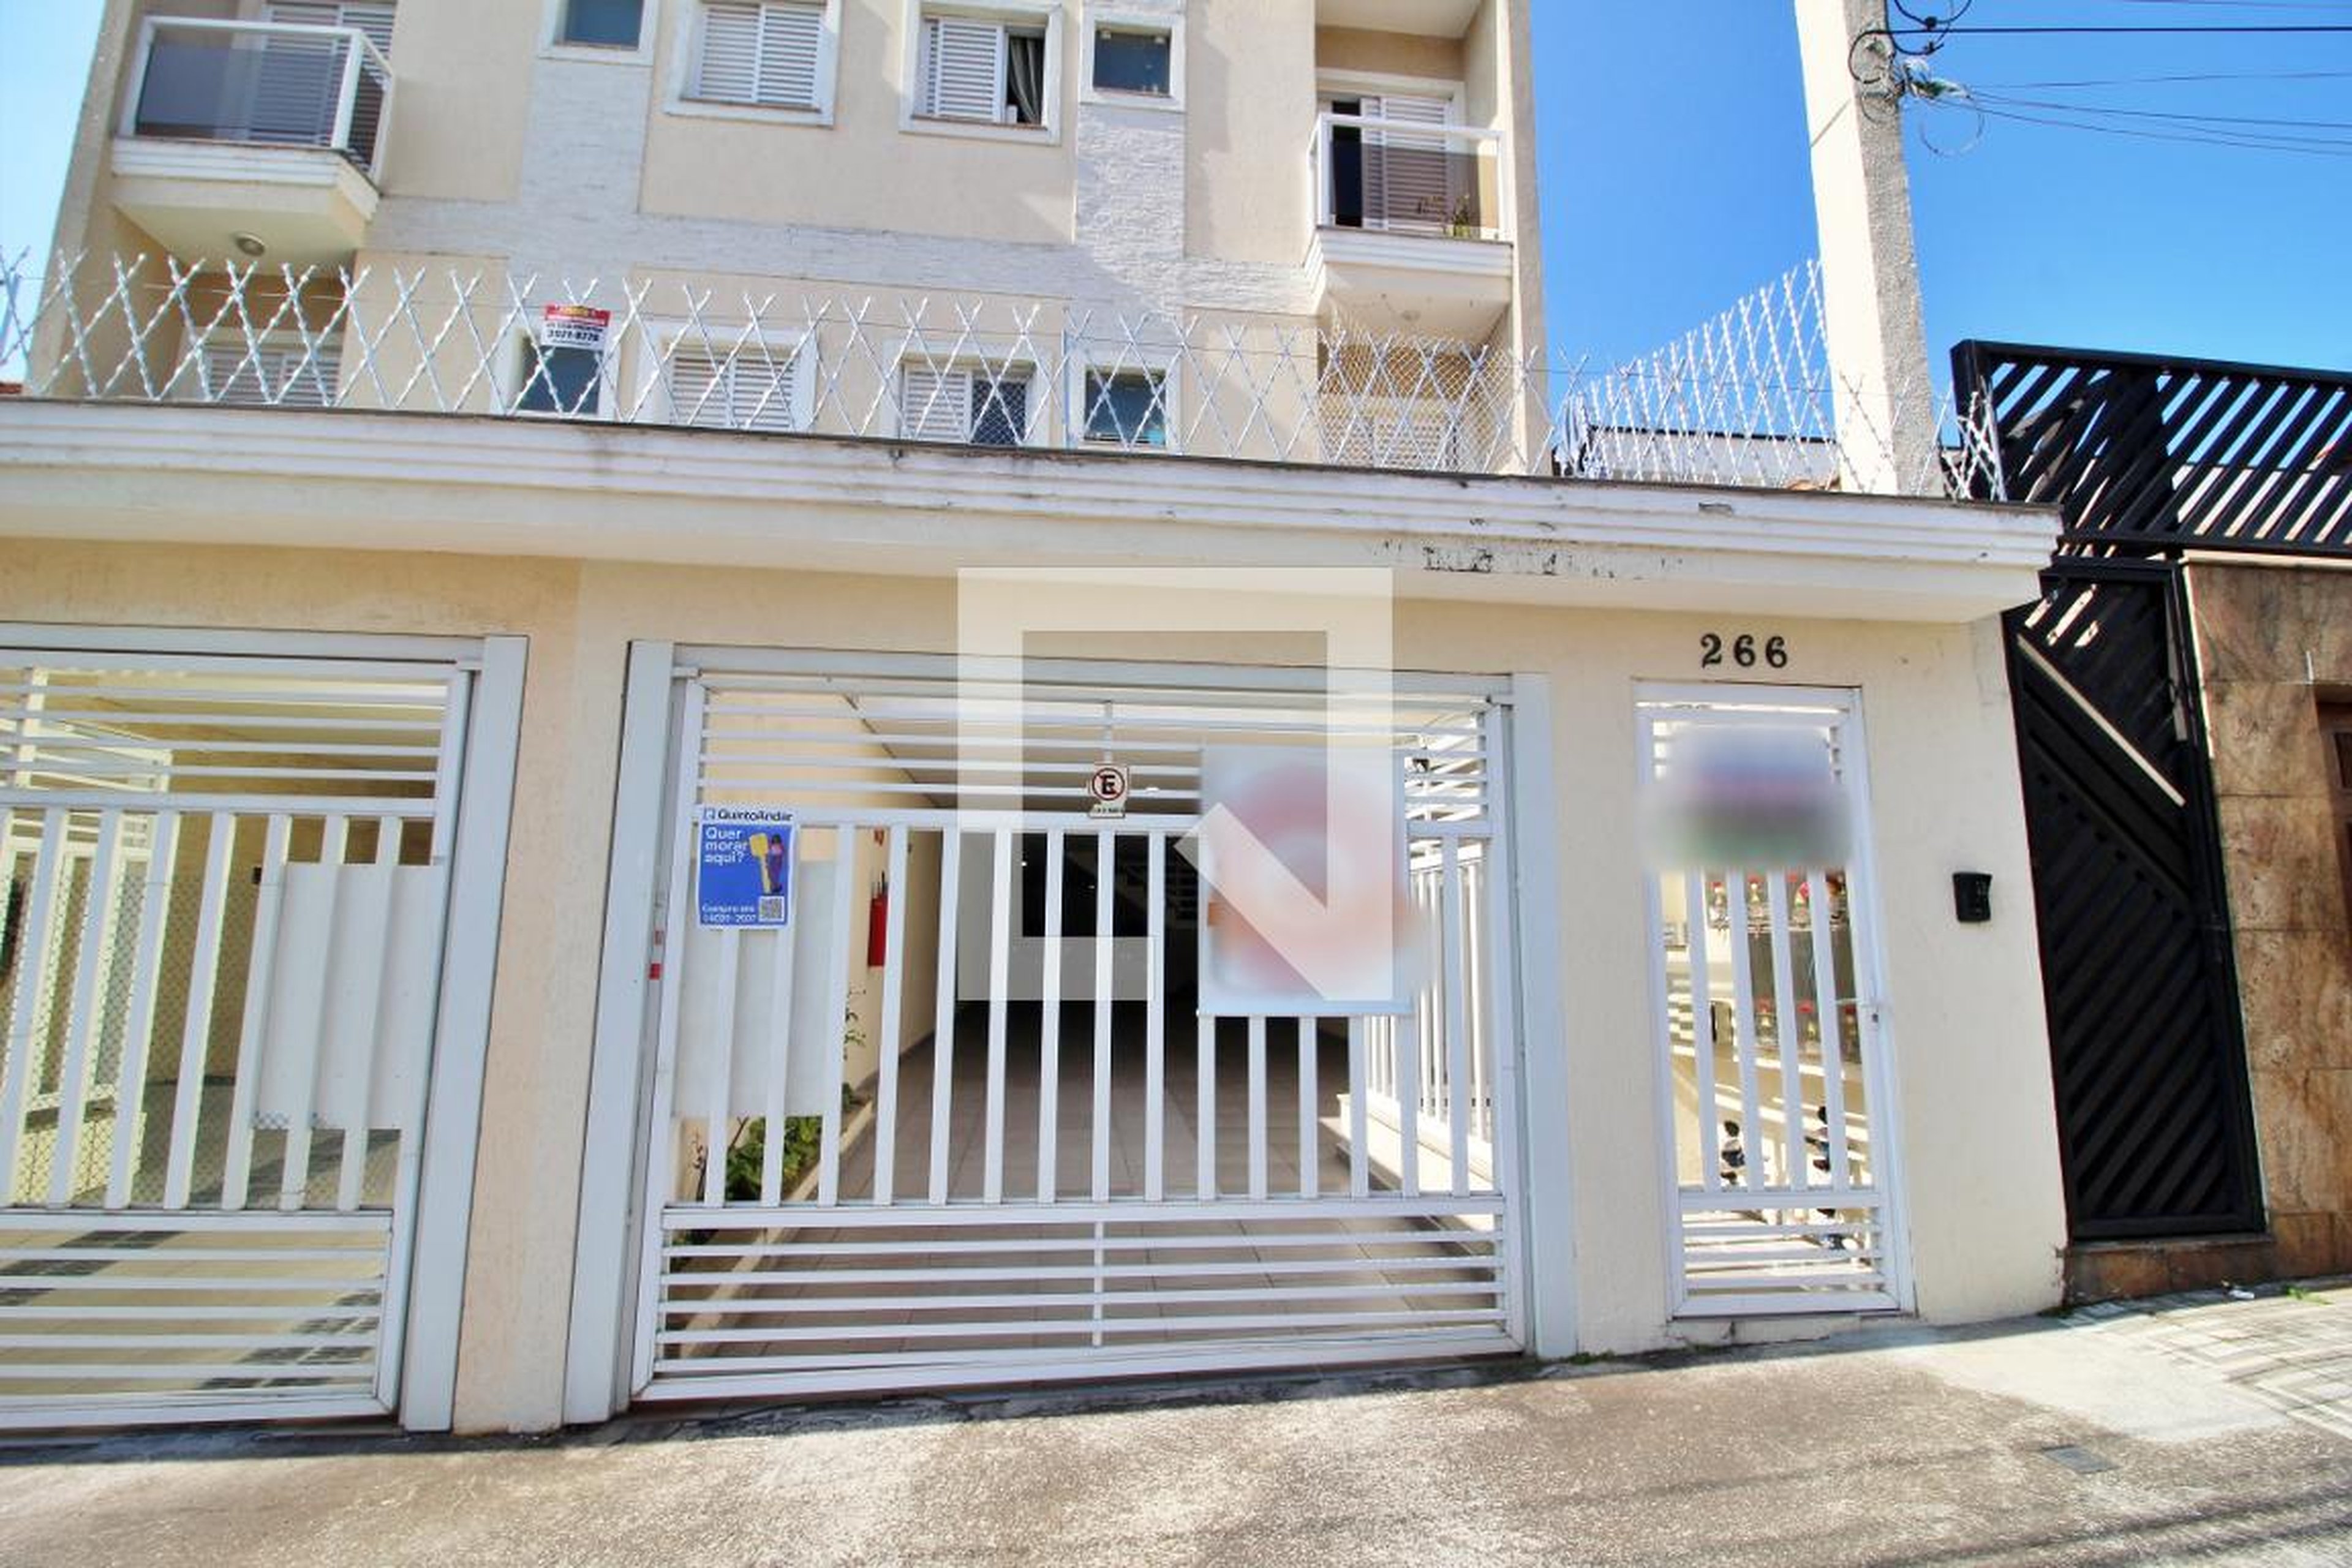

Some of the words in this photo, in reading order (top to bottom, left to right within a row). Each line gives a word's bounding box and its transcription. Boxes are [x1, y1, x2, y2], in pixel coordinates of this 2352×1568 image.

[1700, 633, 1788, 668] 266
[718, 808, 793, 821] QuintoAndar
[705, 827, 741, 840] Quer
[705, 841, 747, 851] morar
[704, 851, 744, 866] aqui?
